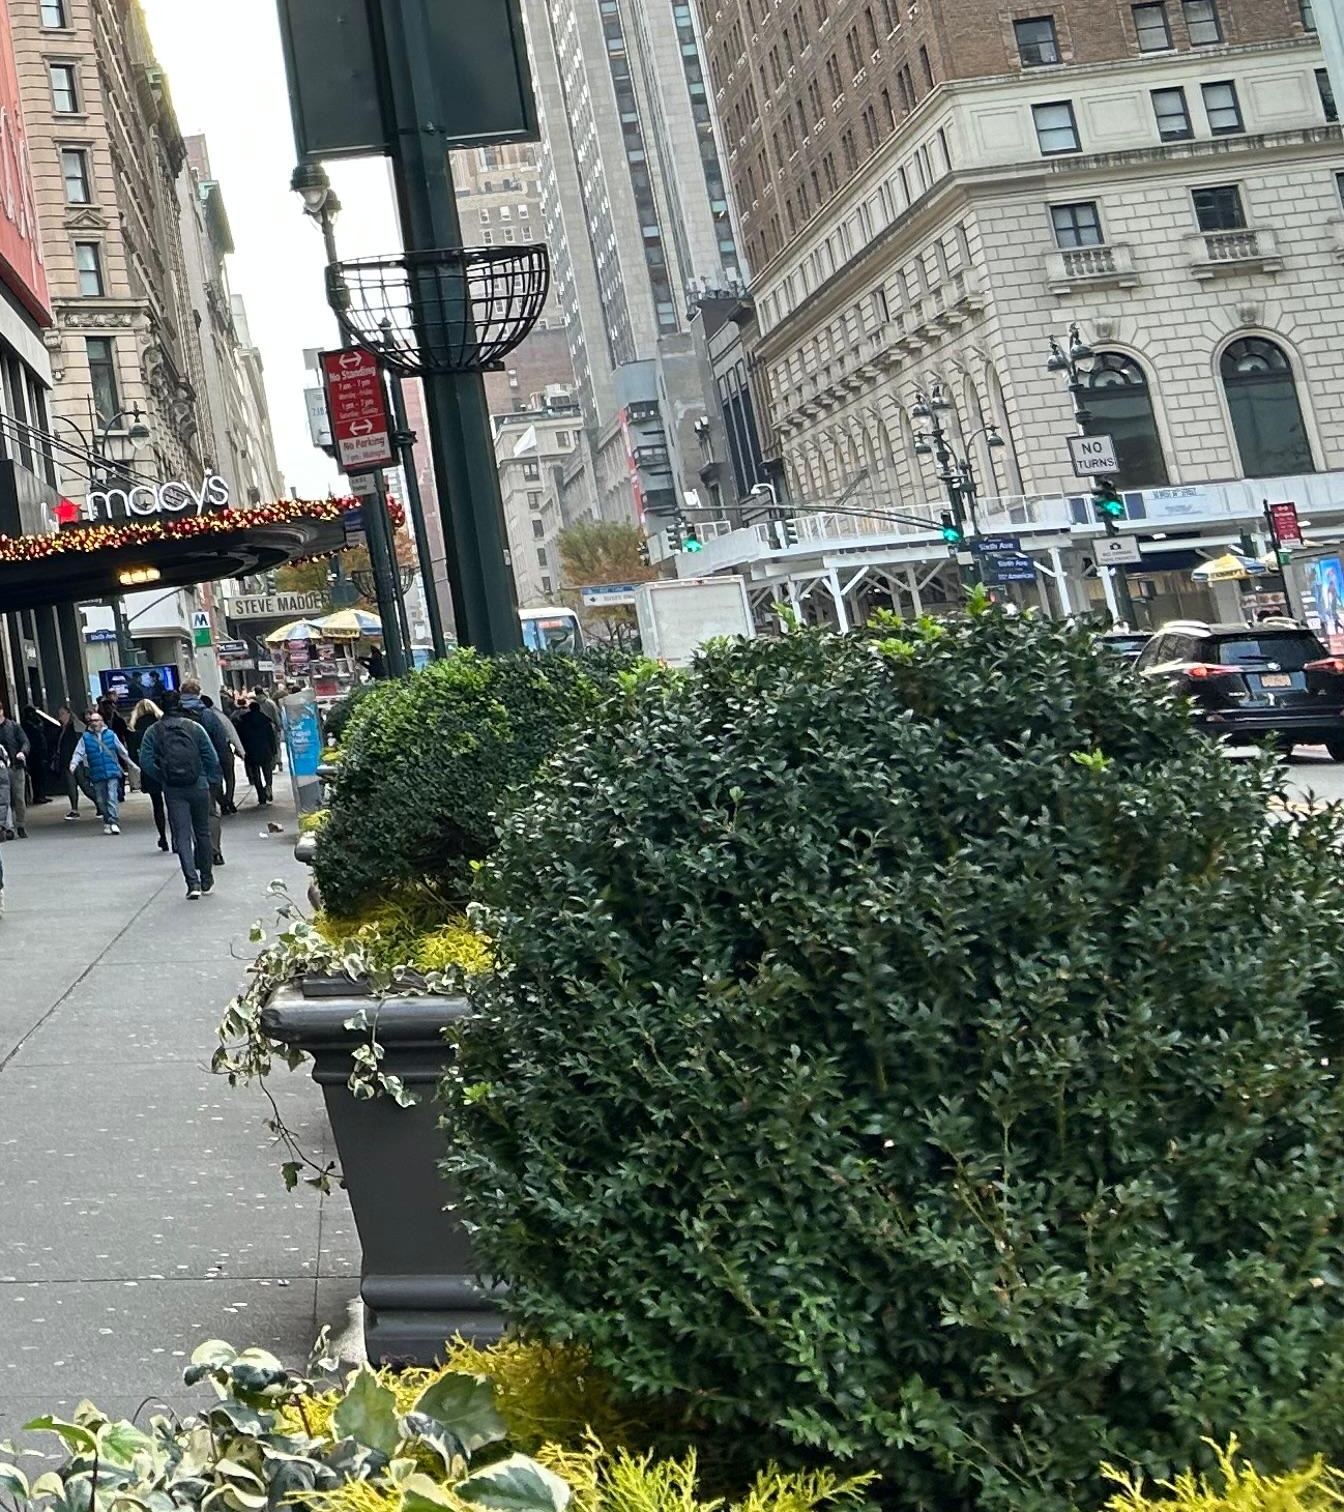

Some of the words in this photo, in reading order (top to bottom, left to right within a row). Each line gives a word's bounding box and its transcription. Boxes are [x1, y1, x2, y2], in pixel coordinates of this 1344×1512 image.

[1081, 441, 1103, 454] NO
[1077, 458, 1116, 469] TURNS
[235, 598, 274, 614] STEVE
